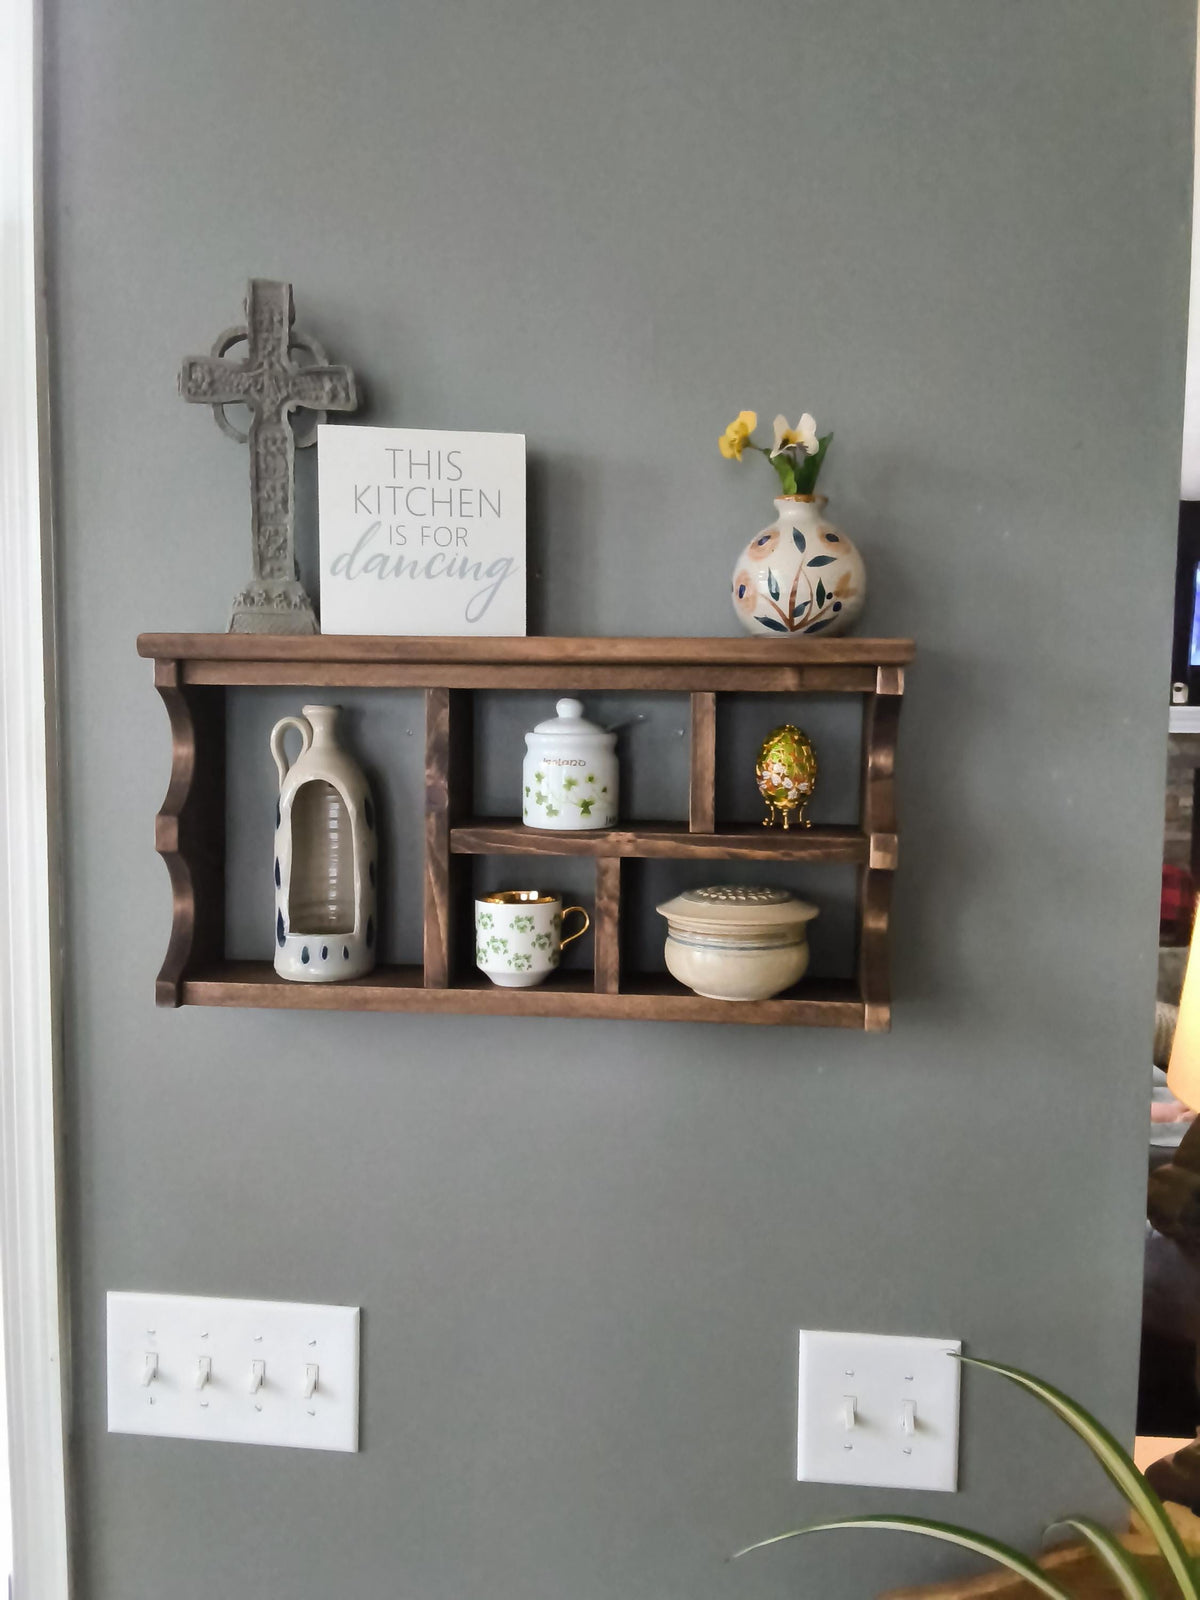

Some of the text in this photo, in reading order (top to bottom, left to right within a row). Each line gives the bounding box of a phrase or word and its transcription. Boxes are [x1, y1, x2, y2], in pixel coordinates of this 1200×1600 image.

[384, 447, 464, 482] THIS
[354, 484, 502, 519] KITCHEN
[389, 524, 469, 548] IS FOR
[329, 520, 520, 624] dancing
